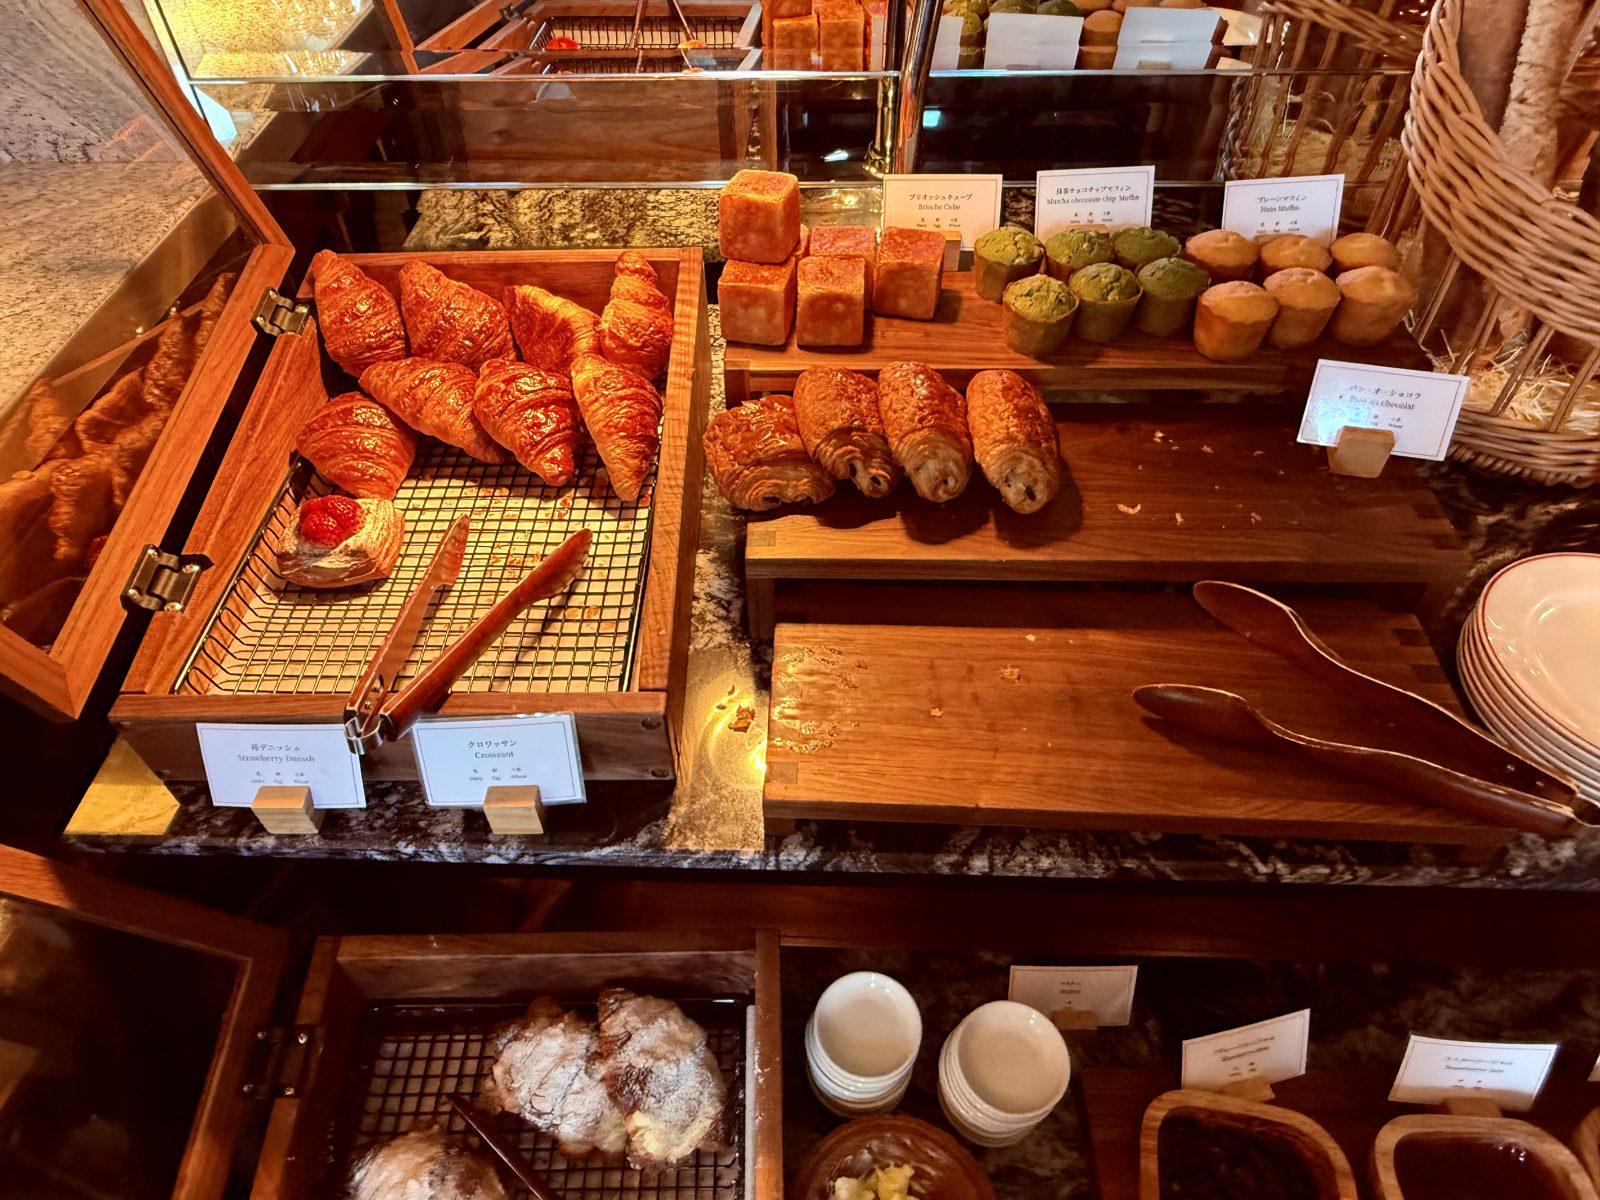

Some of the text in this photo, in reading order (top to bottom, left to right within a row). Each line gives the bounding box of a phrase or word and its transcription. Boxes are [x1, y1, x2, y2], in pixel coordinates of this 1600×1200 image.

[468, 740, 518, 749] クロワッサン
